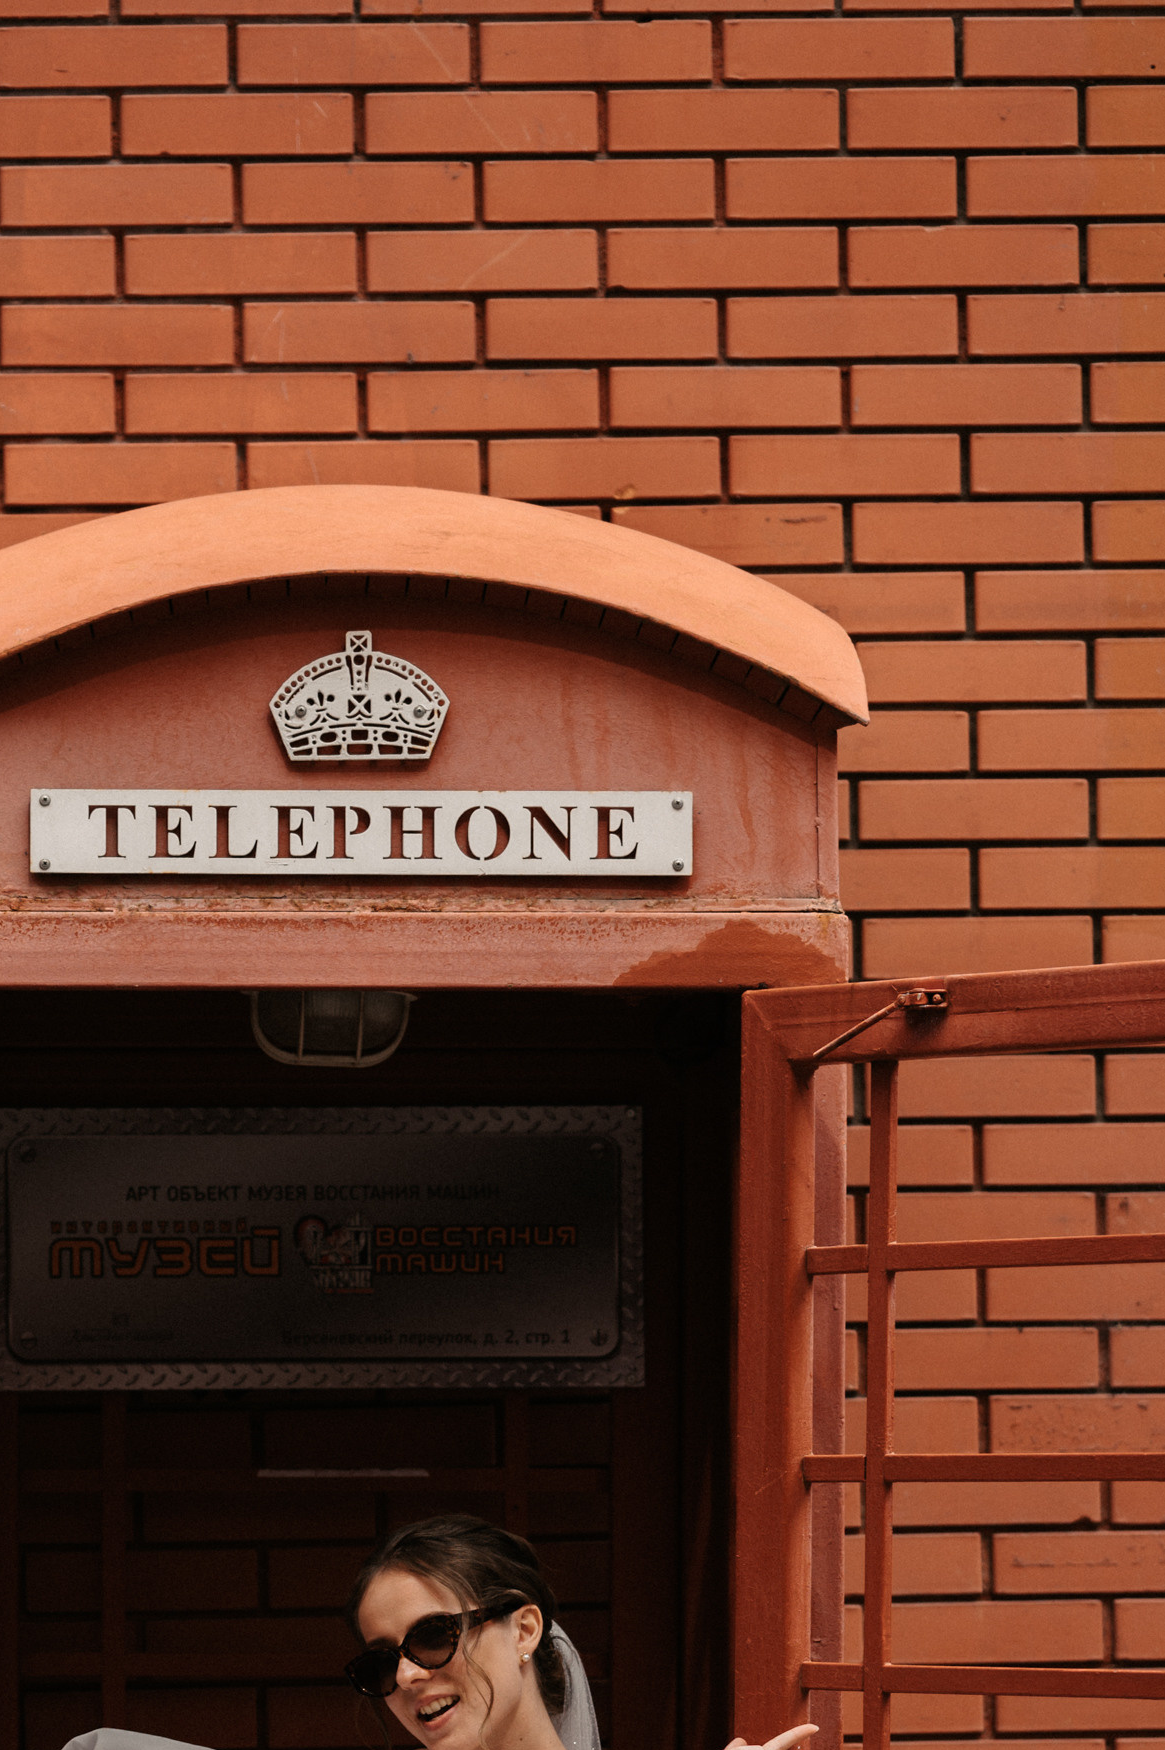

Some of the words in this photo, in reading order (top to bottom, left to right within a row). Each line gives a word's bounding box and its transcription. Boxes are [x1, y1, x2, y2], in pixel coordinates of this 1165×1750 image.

[87, 804, 639, 862] TELEPHONE
[125, 1185, 161, 1202] АРТ
[166, 1185, 243, 1202] ОБЪЕКТ
[247, 1184, 307, 1201] МУЗЕЯ
[313, 1184, 420, 1201] ВОССТАНИЯ
[427, 1183, 501, 1200] МАШИН
[375, 1225, 578, 1247] ВОССТАНИЯ
[375, 1252, 506, 1273] МАШИН
[398, 1332, 477, 1347] переулок,
[483, 1332, 499, 1347] д.
[505, 1329, 520, 1346] 2,
[524, 1332, 555, 1347] стр.
[561, 1329, 570, 1344] 1
